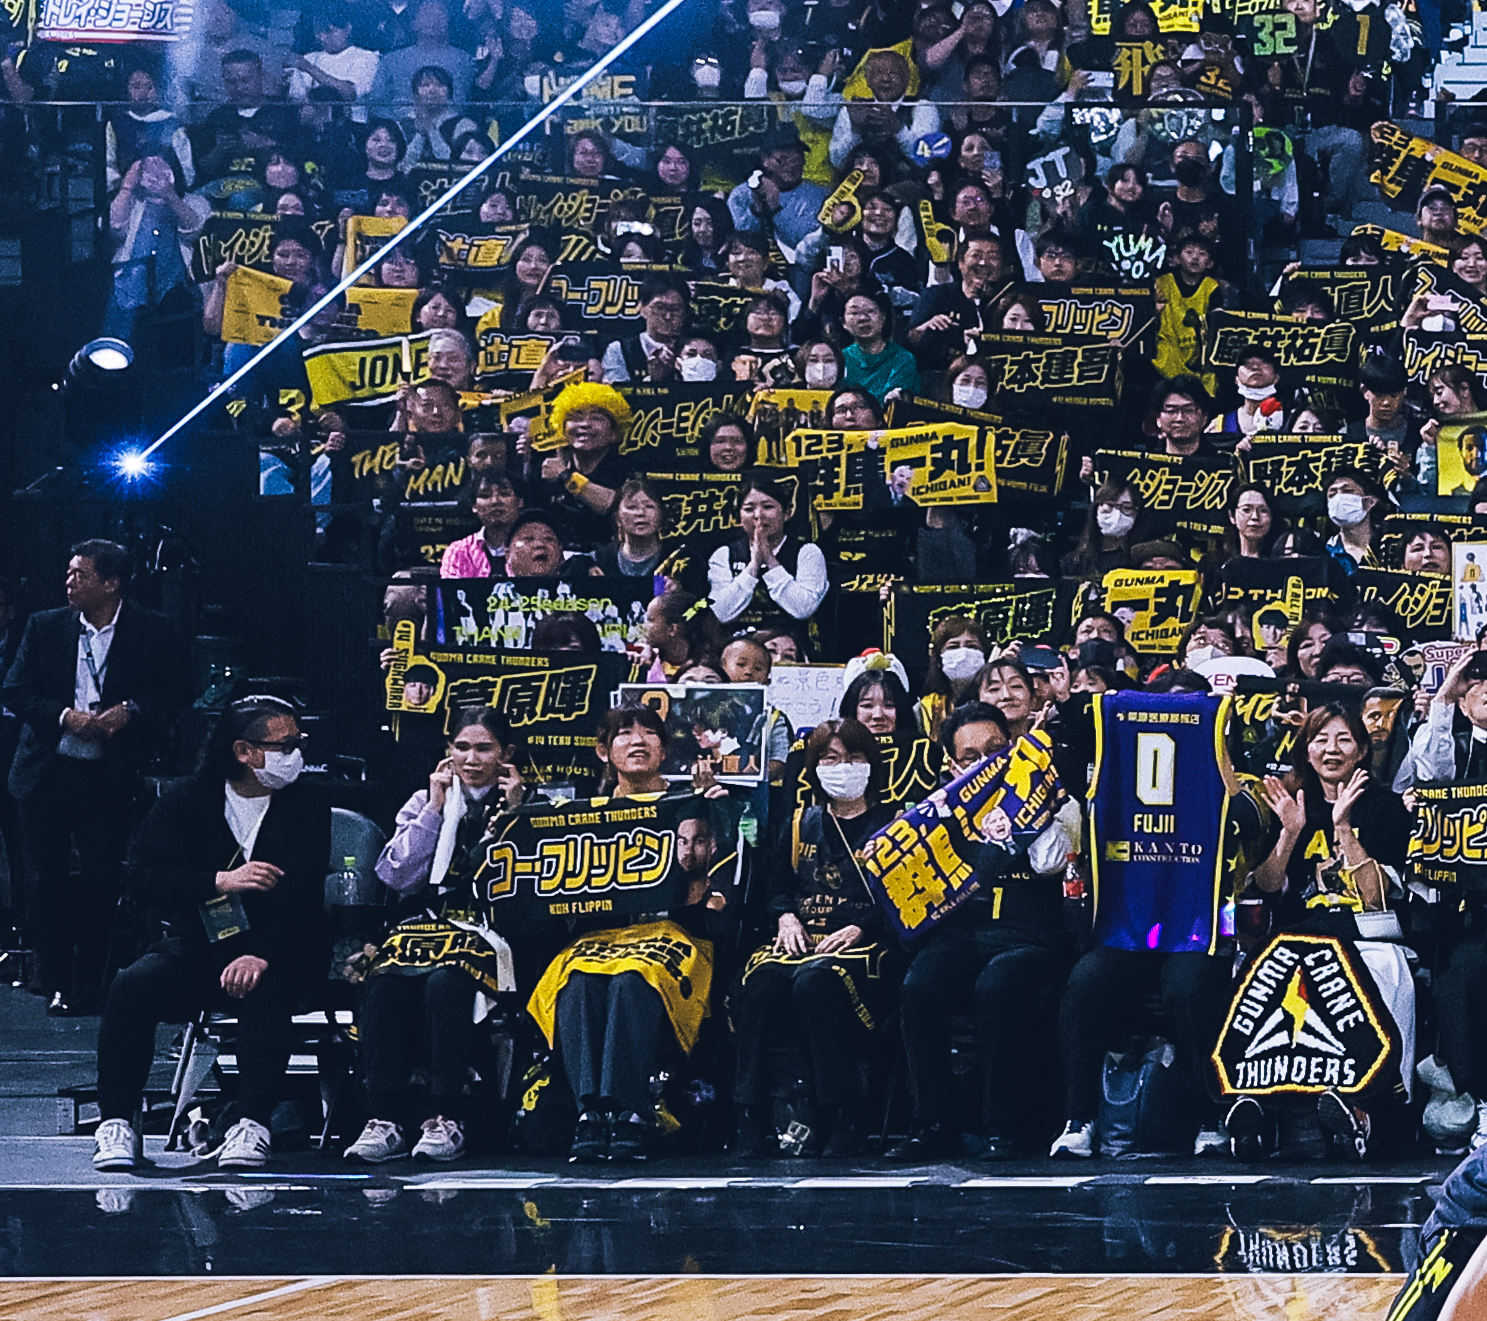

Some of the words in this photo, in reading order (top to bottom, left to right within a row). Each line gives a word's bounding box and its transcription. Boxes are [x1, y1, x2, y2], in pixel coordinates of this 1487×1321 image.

[1252, 12, 1297, 57] 32
[891, 431, 938, 448] GUNMA
[1114, 576, 1165, 588] GUNMA
[1134, 814, 1175, 833] FUJII
[1134, 842, 1203, 855] KANTO
[1233, 946, 1299, 1035] GUNMA
[1304, 949, 1364, 1032] CRANE
[1236, 1055, 1355, 1088] THUNDERS
